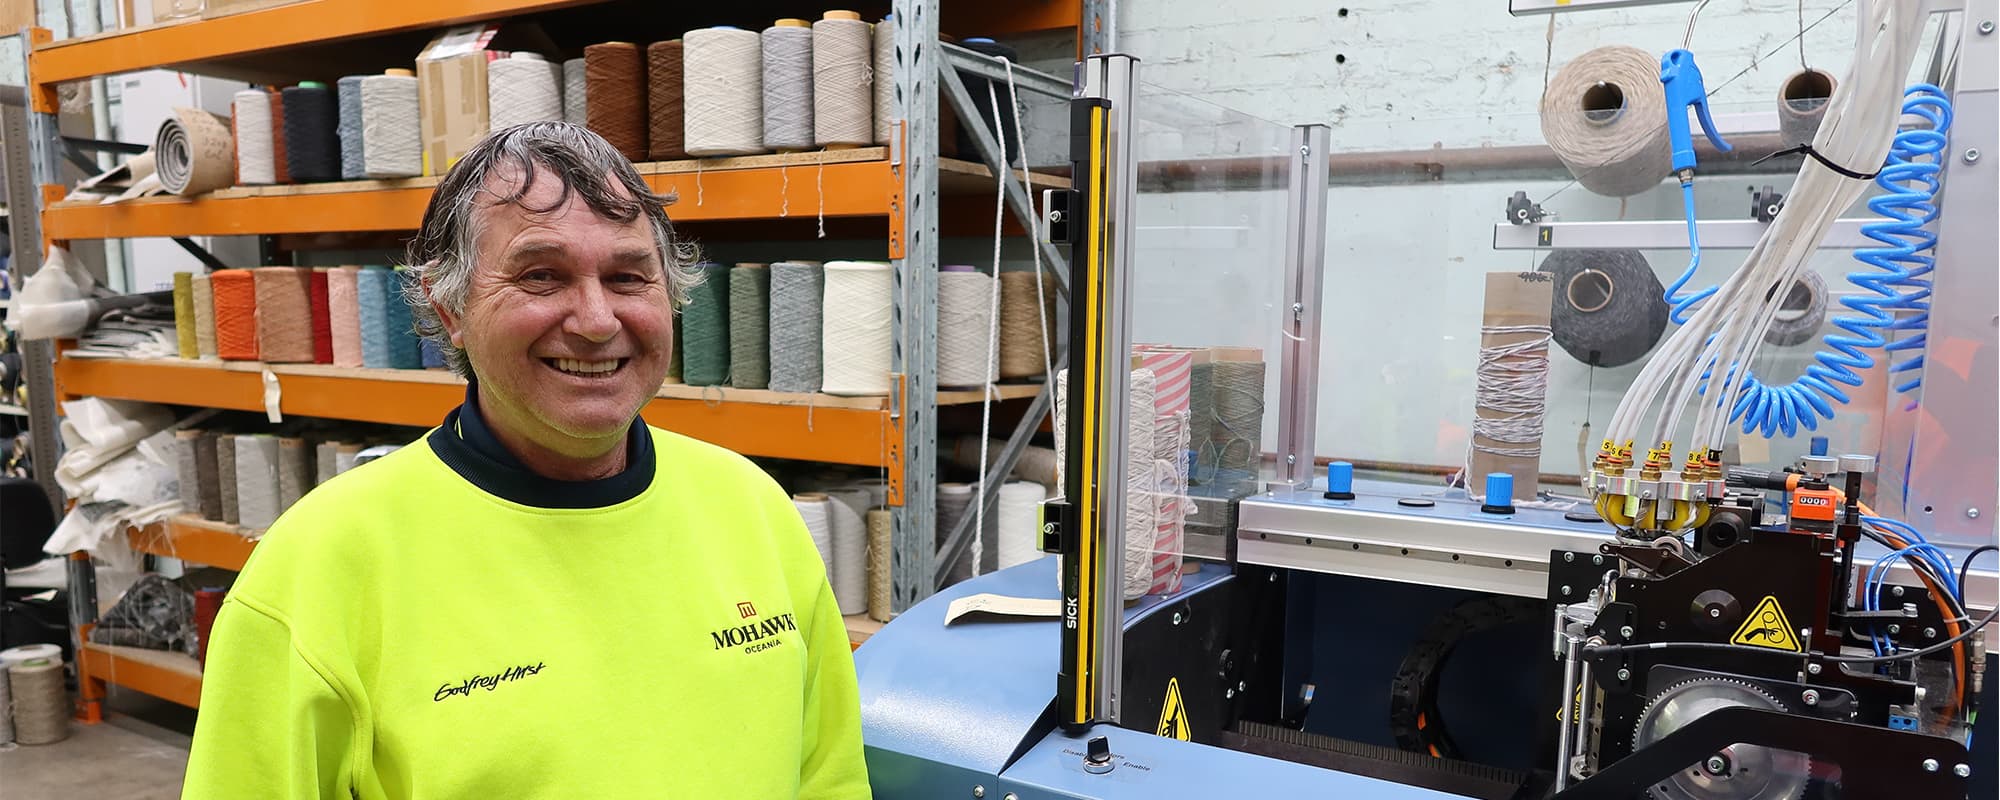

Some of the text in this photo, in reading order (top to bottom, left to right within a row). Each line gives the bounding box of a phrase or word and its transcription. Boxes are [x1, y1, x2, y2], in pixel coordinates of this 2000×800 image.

[1542, 230, 1548, 241] 1
[1066, 597, 1078, 630] SICK
[711, 613, 796, 650] MOHAWK
[745, 639, 782, 655] OCEANIA
[434, 675, 501, 702] Godfrey
[1123, 761, 1151, 771] Enable
